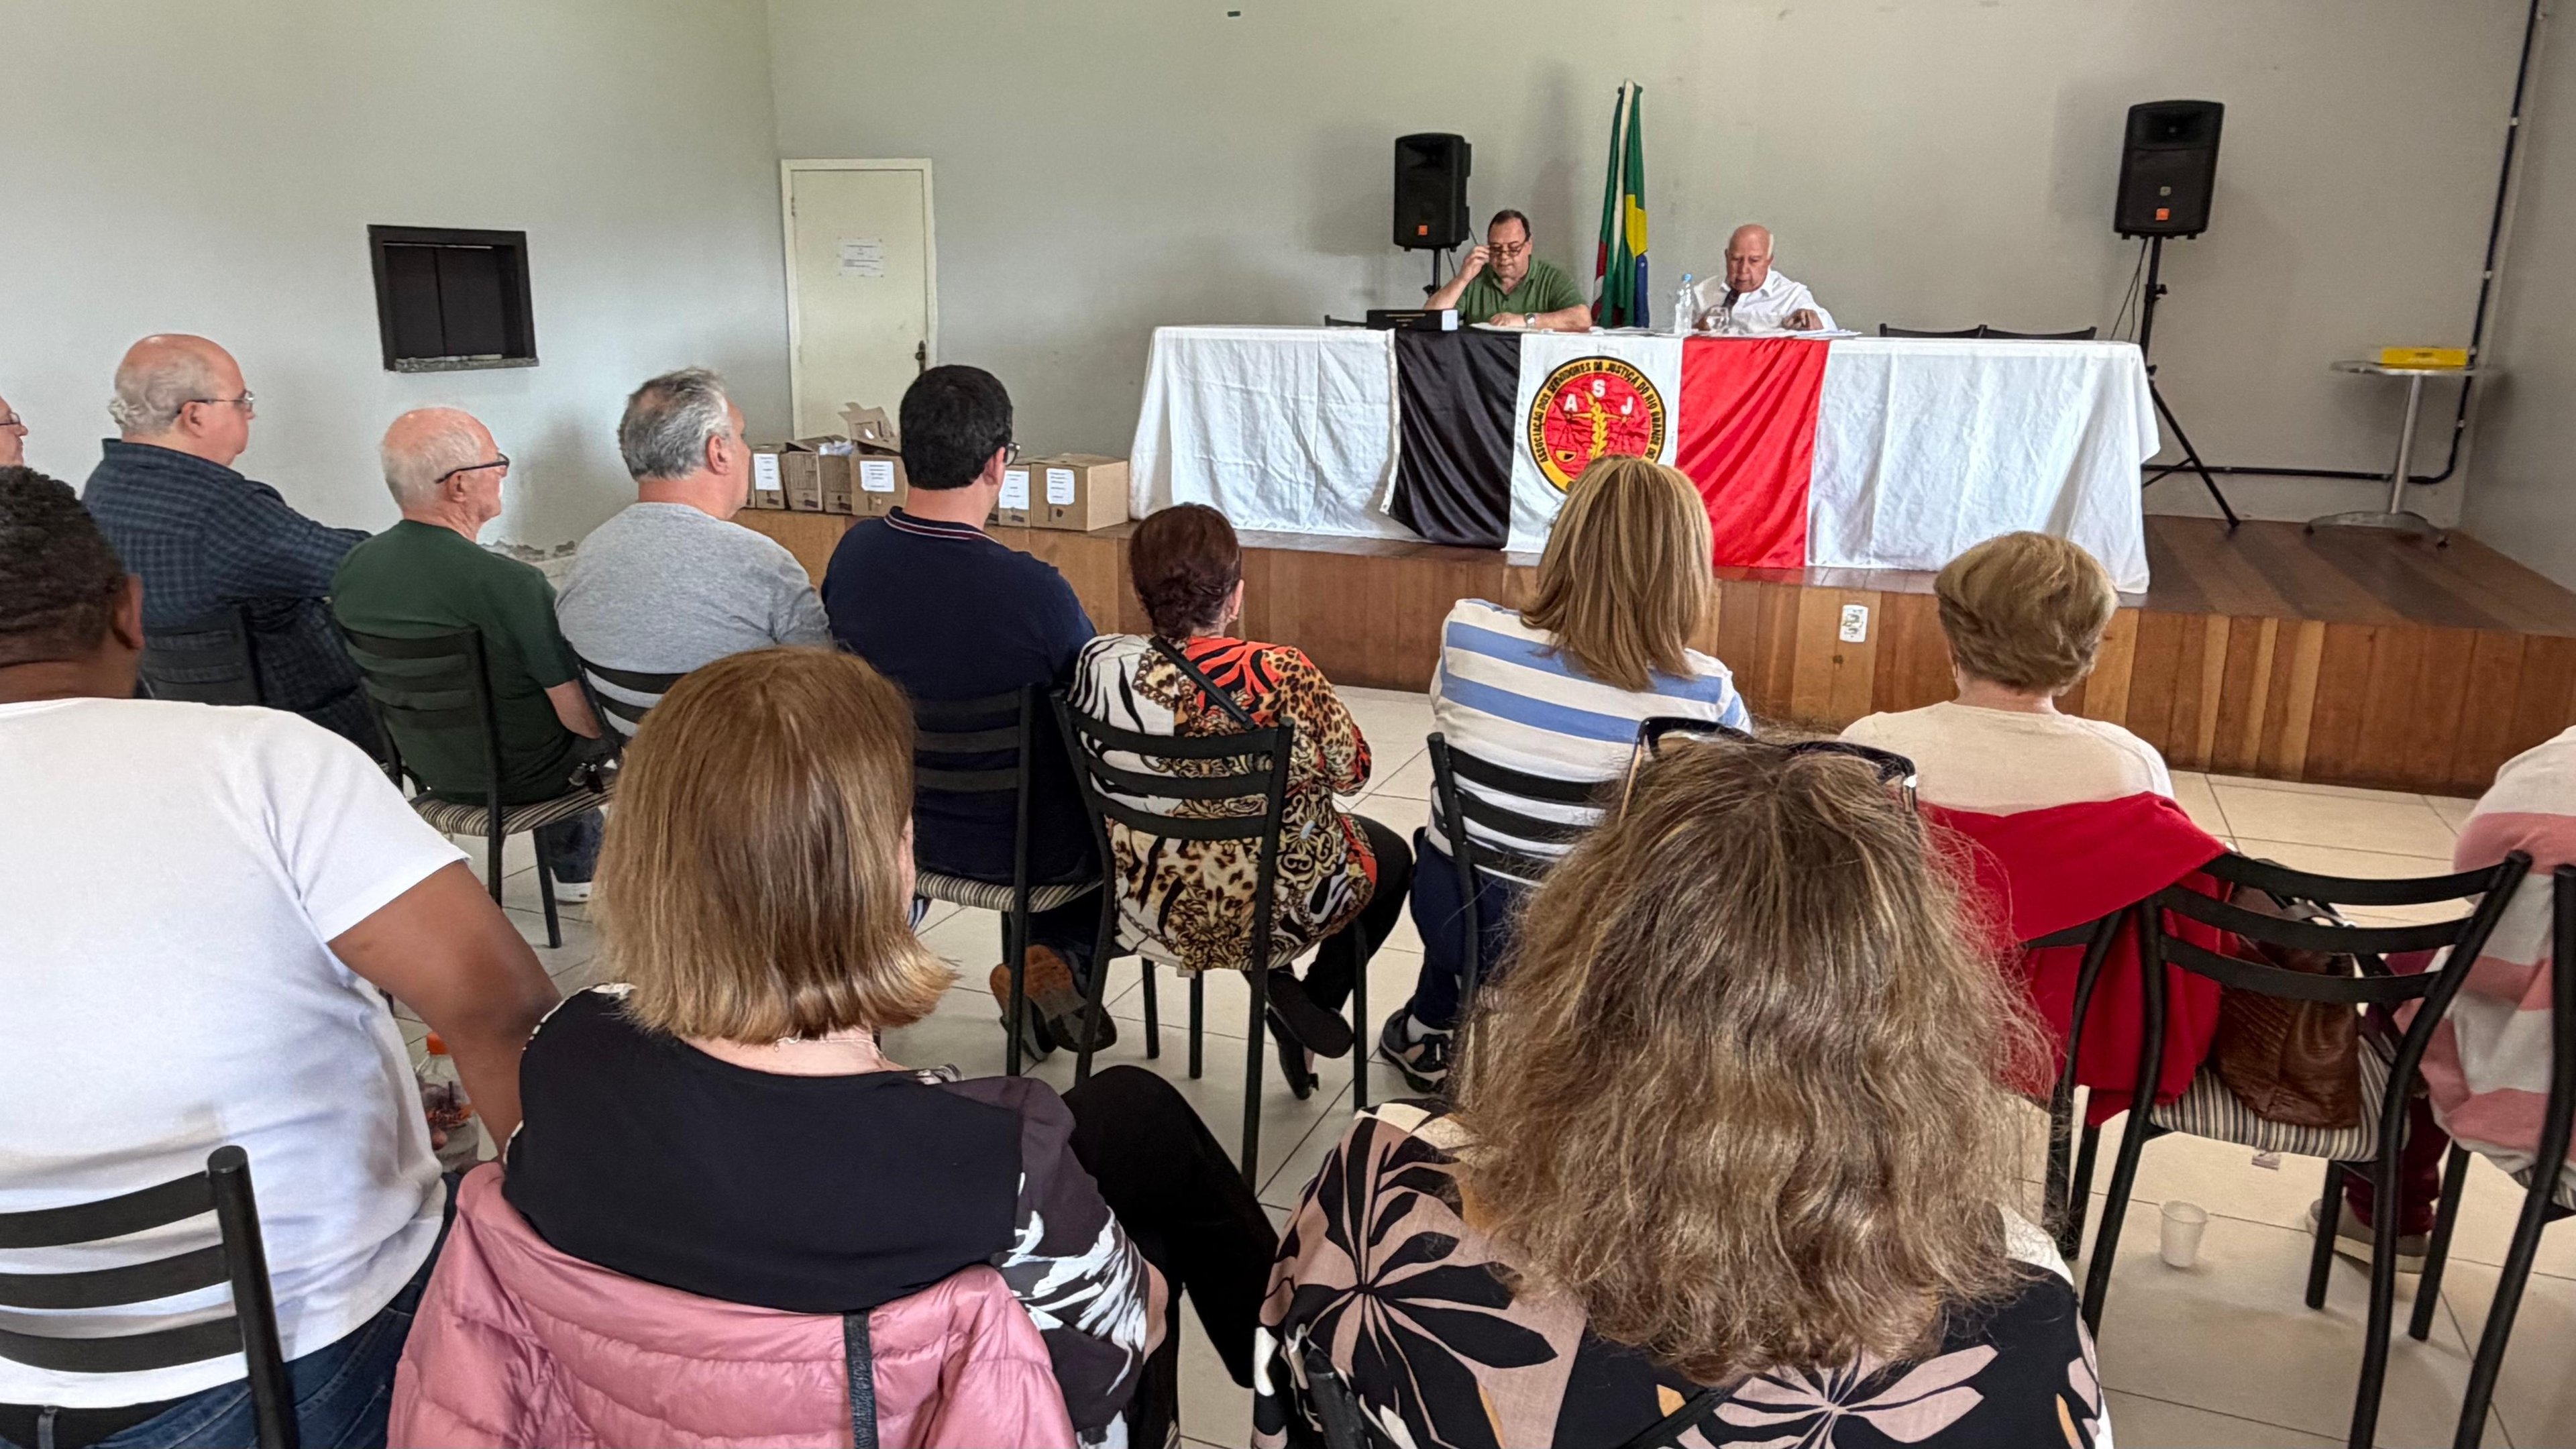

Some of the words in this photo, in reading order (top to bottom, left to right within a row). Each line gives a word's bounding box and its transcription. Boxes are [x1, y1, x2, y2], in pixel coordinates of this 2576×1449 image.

[1563, 394, 1578, 412] A
[1592, 379, 1606, 398] S
[1620, 396, 1634, 415] J
[1605, 363, 1640, 386] JUSTIÇA
[1637, 381, 1650, 395] DO
[1645, 394, 1658, 410] RIO
